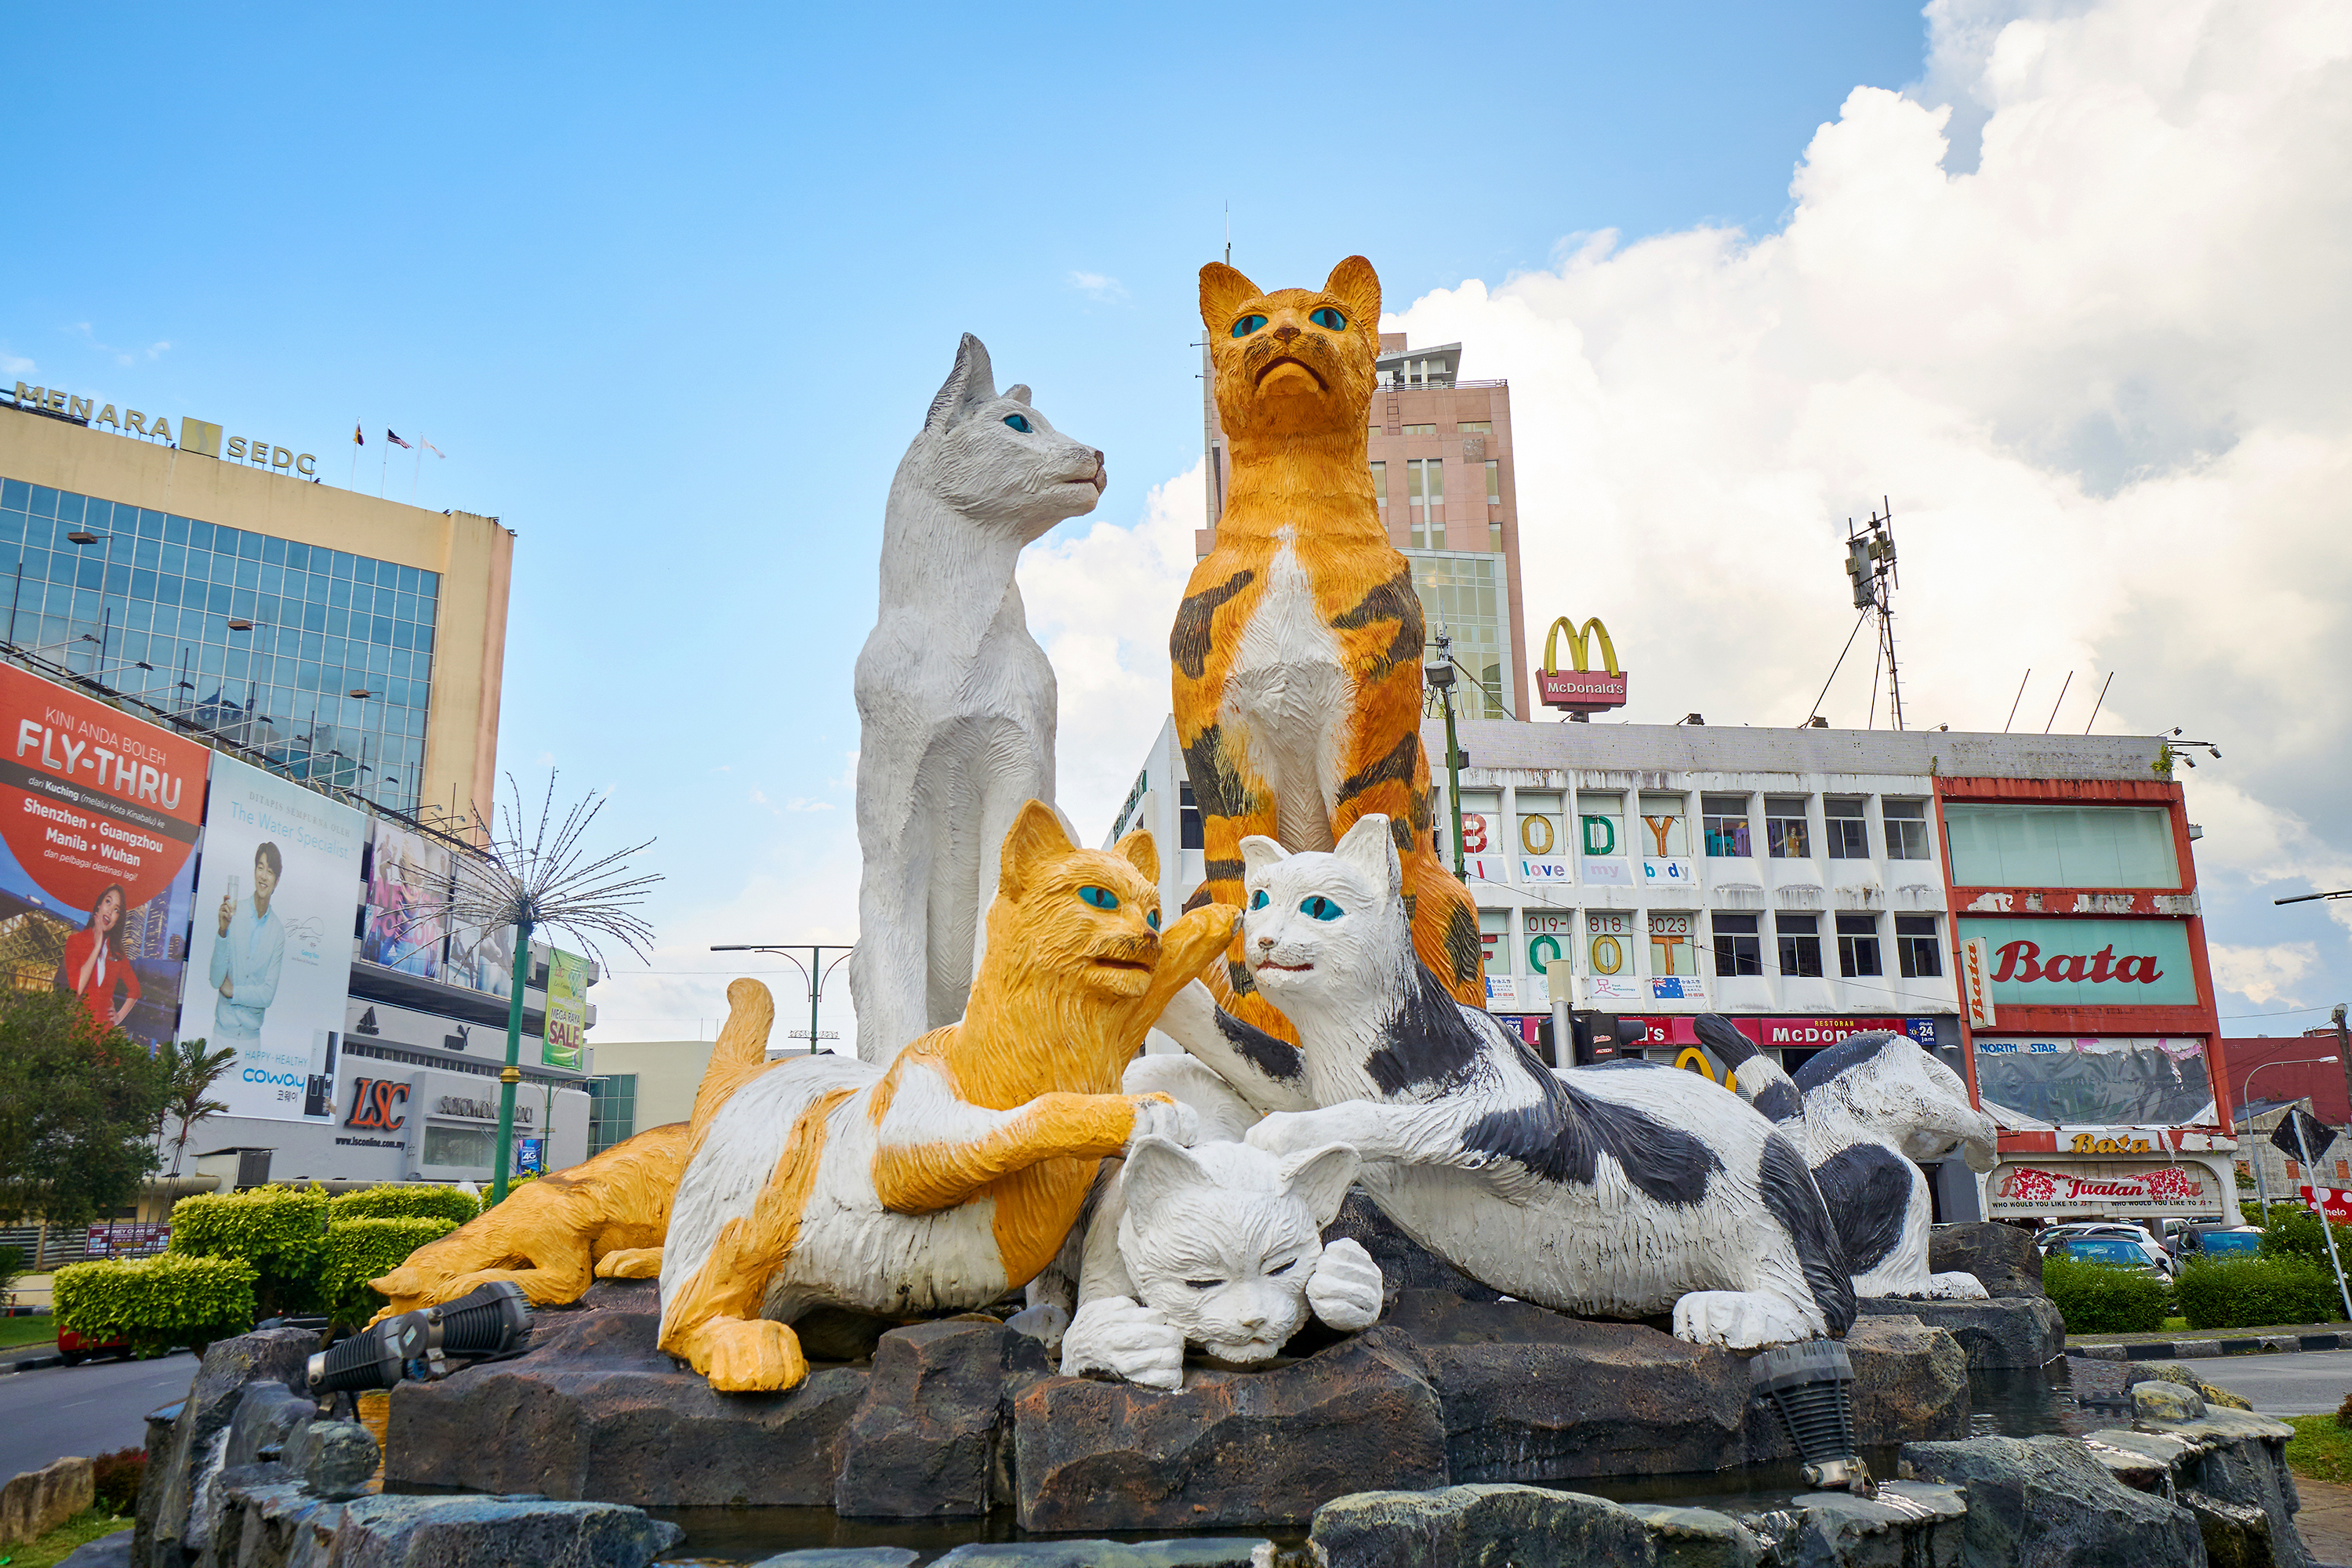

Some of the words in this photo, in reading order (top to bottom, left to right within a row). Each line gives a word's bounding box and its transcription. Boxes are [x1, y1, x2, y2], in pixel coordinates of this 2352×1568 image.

[14, 381, 172, 441] MENARA
[227, 436, 317, 475] SEDC
[1548, 681, 1624, 695] McDonald's
[45, 707, 75, 731] KINI
[78, 720, 119, 748] ANDA
[122, 737, 166, 766] BOLEH
[16, 718, 182, 810] FLY-THRU
[28, 777, 45, 788] dari
[45, 782, 79, 800] Kuching
[81, 793, 110, 810] (melalui
[110, 804, 125, 815] Kota
[126, 809, 157, 826] Kinabalu)
[157, 818, 165, 829] ke
[249, 791, 284, 811] DITAPIS
[286, 806, 328, 829] SEMPURNA
[331, 823, 350, 837] OLEH
[24, 797, 87, 829] Shenzhen
[100, 822, 163, 853] Guangzhou
[231, 801, 254, 824] The
[259, 811, 294, 838] Water
[45, 827, 87, 851] Manila
[100, 843, 140, 867] Wuhan
[1461, 813, 1675, 858] BODY
[44, 849, 59, 859] dan
[59, 853, 92, 869] pelbagai
[93, 859, 123, 877] destinasi
[123, 867, 138, 882] lagi!
[1523, 861, 1565, 877] love
[1591, 865, 1619, 878] my
[1644, 862, 1689, 881] body
[1590, 917, 1621, 931] 818
[1990, 939, 2164, 984] Bata
[1968, 942, 1984, 1023] Bata
[550, 1007, 567, 1020] MEGA
[568, 1012, 581, 1025] RAYA
[1919, 1026, 1934, 1036] 24
[549, 1019, 581, 1049] SALE
[1980, 1044, 2017, 1053] NORTH
[2031, 1044, 2057, 1053] STAR
[245, 1051, 270, 1062] HAPPY
[275, 1054, 309, 1067] HEALTHY
[242, 1068, 306, 1094] coway
[343, 1076, 412, 1132] LSC
[335, 1136, 406, 1152] www.lsconline.com.my
[522, 1152, 536, 1160] 4G
[2070, 1134, 2151, 1154] Bata
[2065, 1179, 2144, 1199] Jualan
[2325, 1207, 2347, 1216] helo
